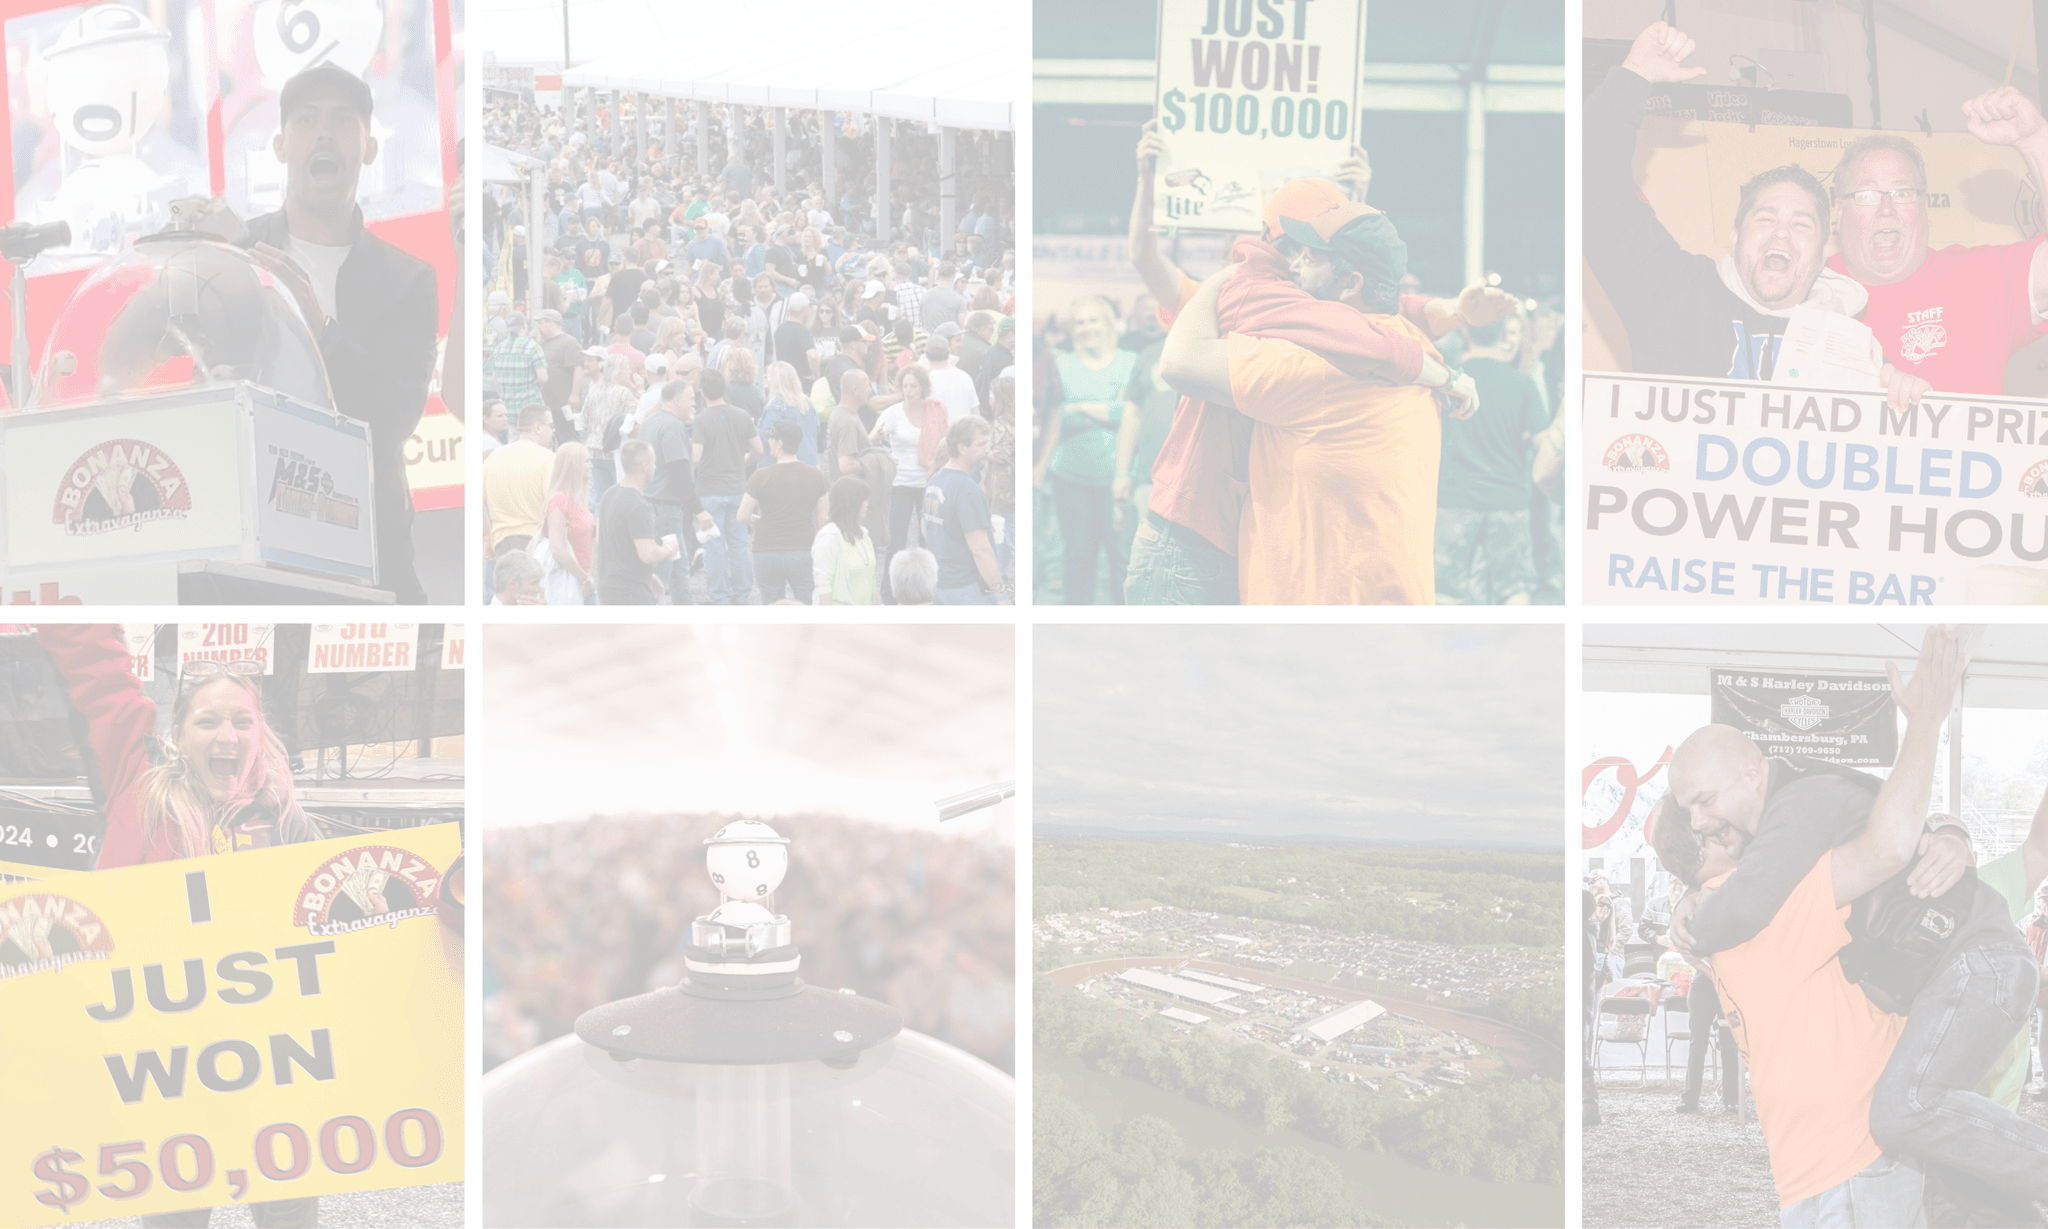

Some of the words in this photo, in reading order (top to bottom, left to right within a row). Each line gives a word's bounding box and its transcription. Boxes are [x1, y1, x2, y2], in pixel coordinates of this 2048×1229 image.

[1202, 0, 1313, 41] JUST
[1191, 38, 1321, 94] WON!
[1706, 90, 1748, 107] Video
[1161, 88, 1349, 140] $100,000
[1788, 136, 1838, 150] Hagerstown
[1167, 195, 1204, 220] Lite
[1907, 306, 1943, 323] STAFF
[1610, 383, 1620, 418] I
[1634, 386, 1746, 426] JUST
[1760, 393, 1862, 433] HAD
[1878, 400, 1953, 439] MY
[1607, 435, 1667, 464] BONANZA
[61, 444, 182, 508] BONANZA
[1608, 459, 1668, 475] Extravaganza
[1695, 433, 2003, 499] DOUBLED
[65, 508, 188, 536] Extravaganza
[1586, 485, 1861, 549] POWER
[1608, 553, 1735, 595] RAISE
[1752, 564, 1834, 602] THE
[314, 642, 410, 668] NUMBER
[1717, 674, 1733, 686] M
[1735, 676, 1748, 687] &
[1750, 677, 1760, 688] S
[1762, 678, 1815, 692] Harley
[1817, 680, 1892, 692] Davidson
[1793, 698, 1819, 706] MOTOR
[1743, 731, 1847, 746] Chambersburg,
[1850, 734, 1868, 744] PA
[1768, 746, 1795, 755] (717)
[1796, 747, 1841, 755] 709-9650
[745, 849, 760, 869] 8
[302, 850, 439, 912] BONANZA
[712, 872, 725, 885] 8
[755, 884, 768, 896] 8
[184, 870, 212, 925] I
[84, 940, 337, 1022] JUST
[103, 1027, 337, 1106] WON
[31, 1107, 445, 1215] $50,000
